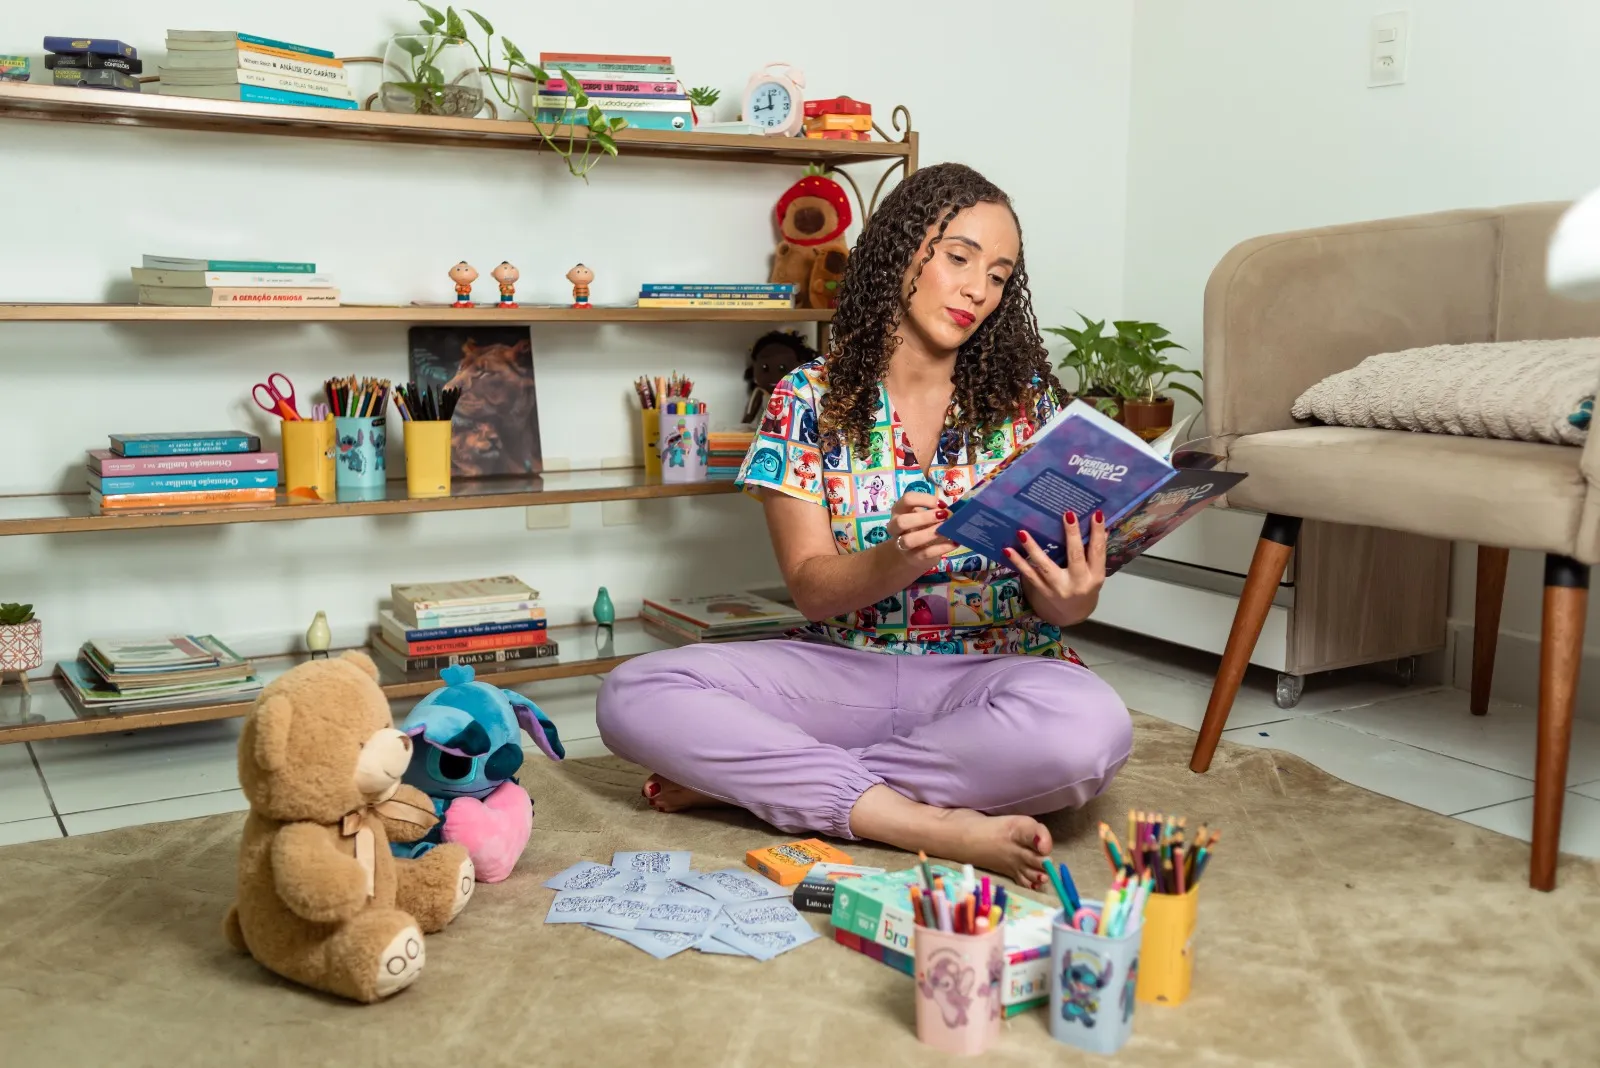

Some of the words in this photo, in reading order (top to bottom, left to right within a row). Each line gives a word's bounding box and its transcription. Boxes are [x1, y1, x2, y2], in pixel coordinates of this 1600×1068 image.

[280, 63, 303, 74] ANÁLISE
[313, 69, 337, 79] CARÁTER
[616, 84, 640, 92] TERAPIA
[239, 293, 272, 302] GERAÇÃO
[157, 460, 188, 469] familiar
[190, 459, 232, 468] Orientação
[1068, 454, 1114, 472] DIVERTIDA
[1076, 466, 1110, 481] MENTE
[1108, 465, 1129, 482] 2
[165, 479, 197, 488] Familiar
[198, 477, 239, 486] Orientação
[1189, 482, 1214, 500] 2
